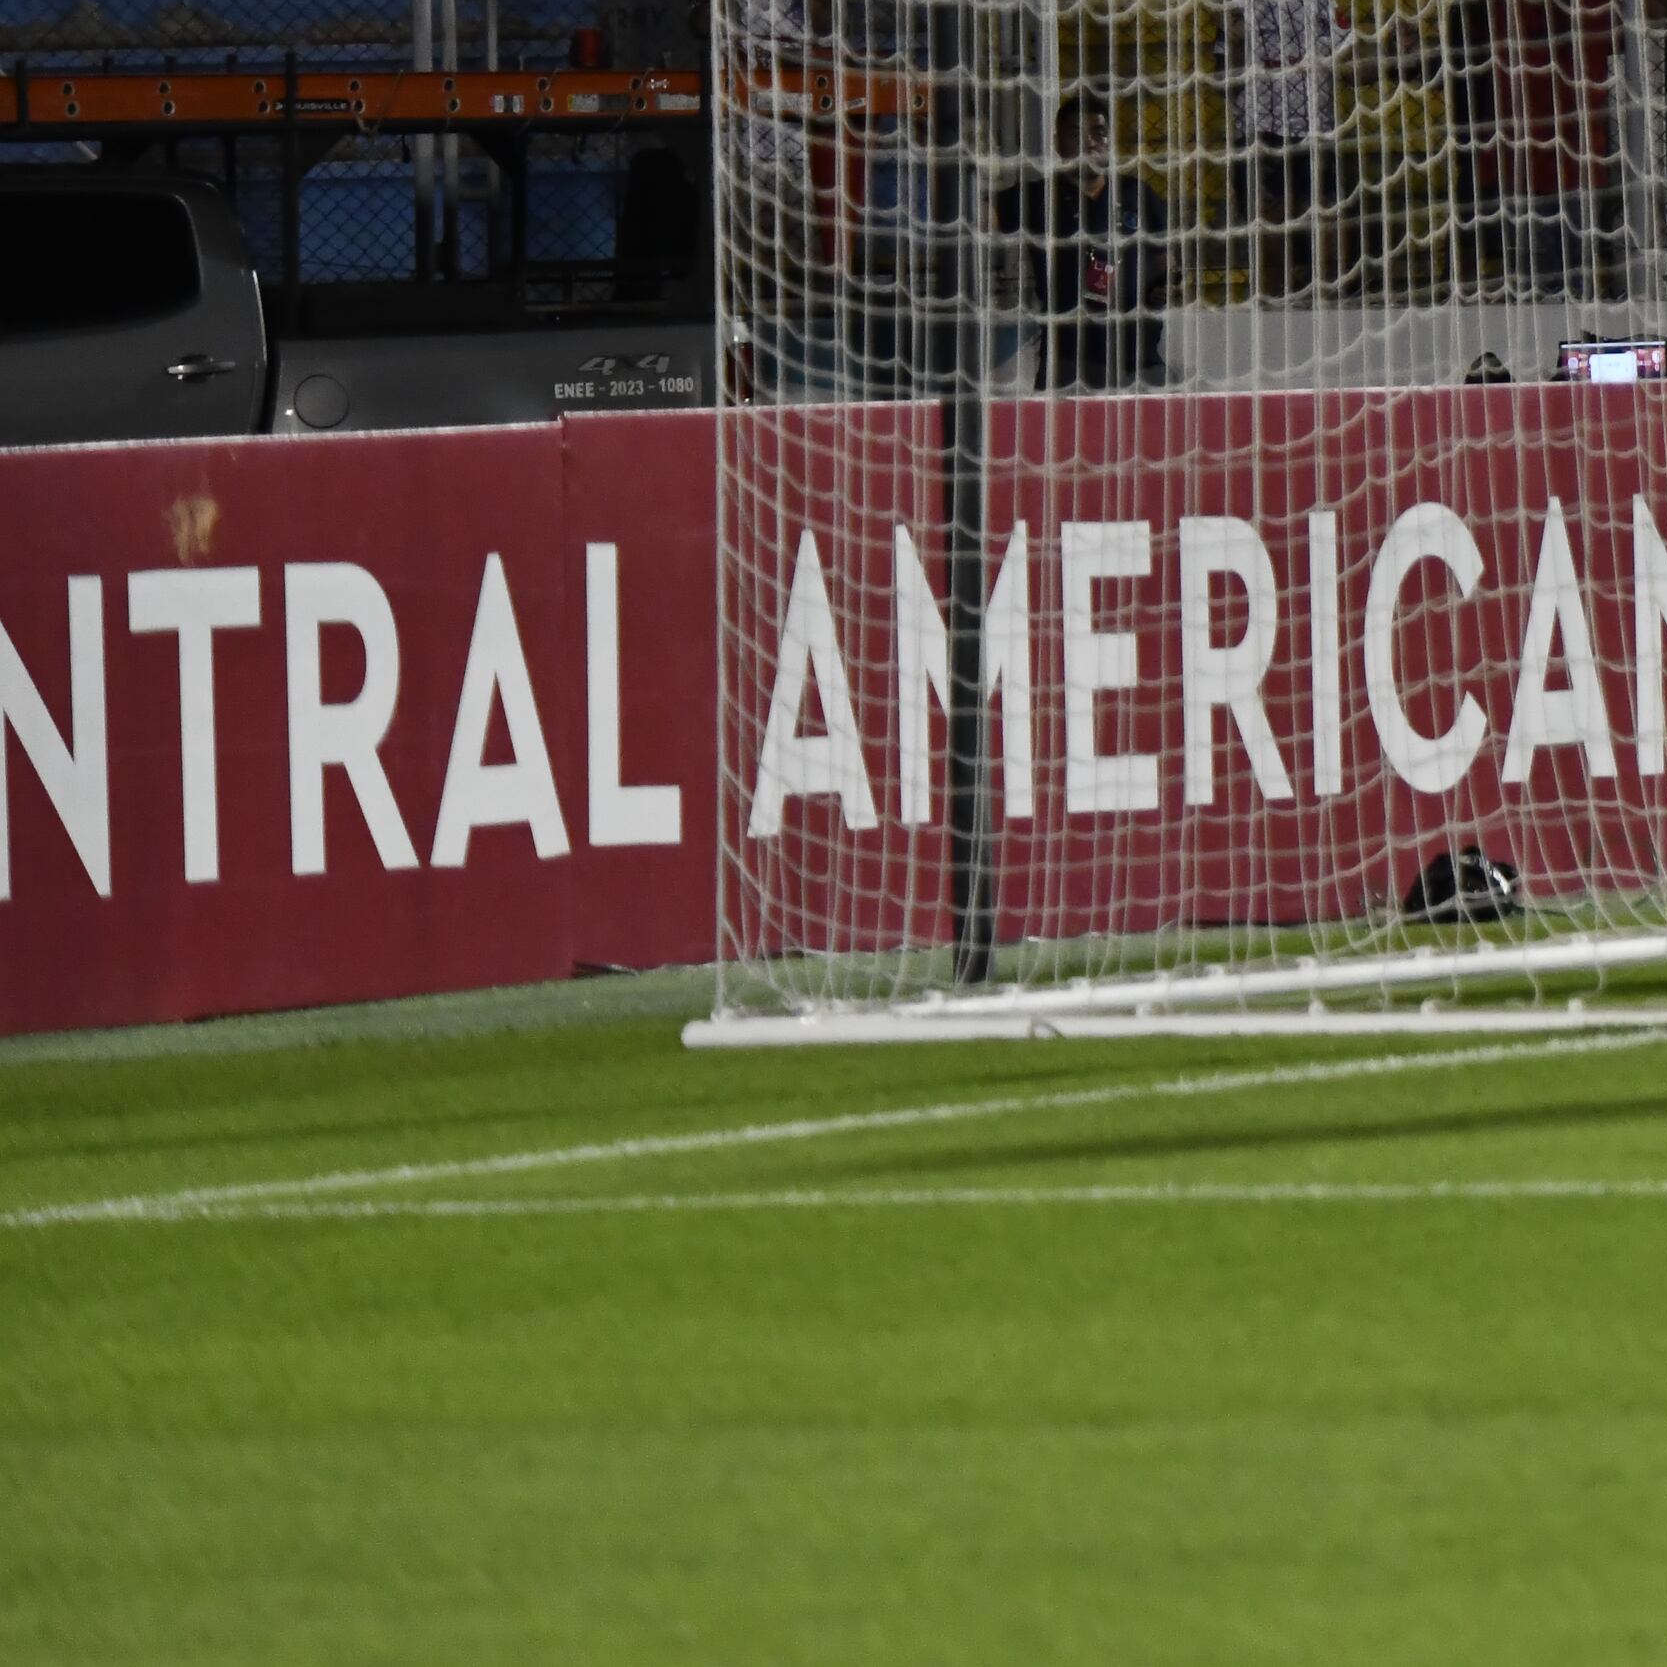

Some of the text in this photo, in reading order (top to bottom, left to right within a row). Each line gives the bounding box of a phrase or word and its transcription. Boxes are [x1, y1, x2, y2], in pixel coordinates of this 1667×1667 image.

[554, 382, 596, 399] ENEE
[609, 379, 645, 397] 2023
[659, 376, 694, 394] 1080
